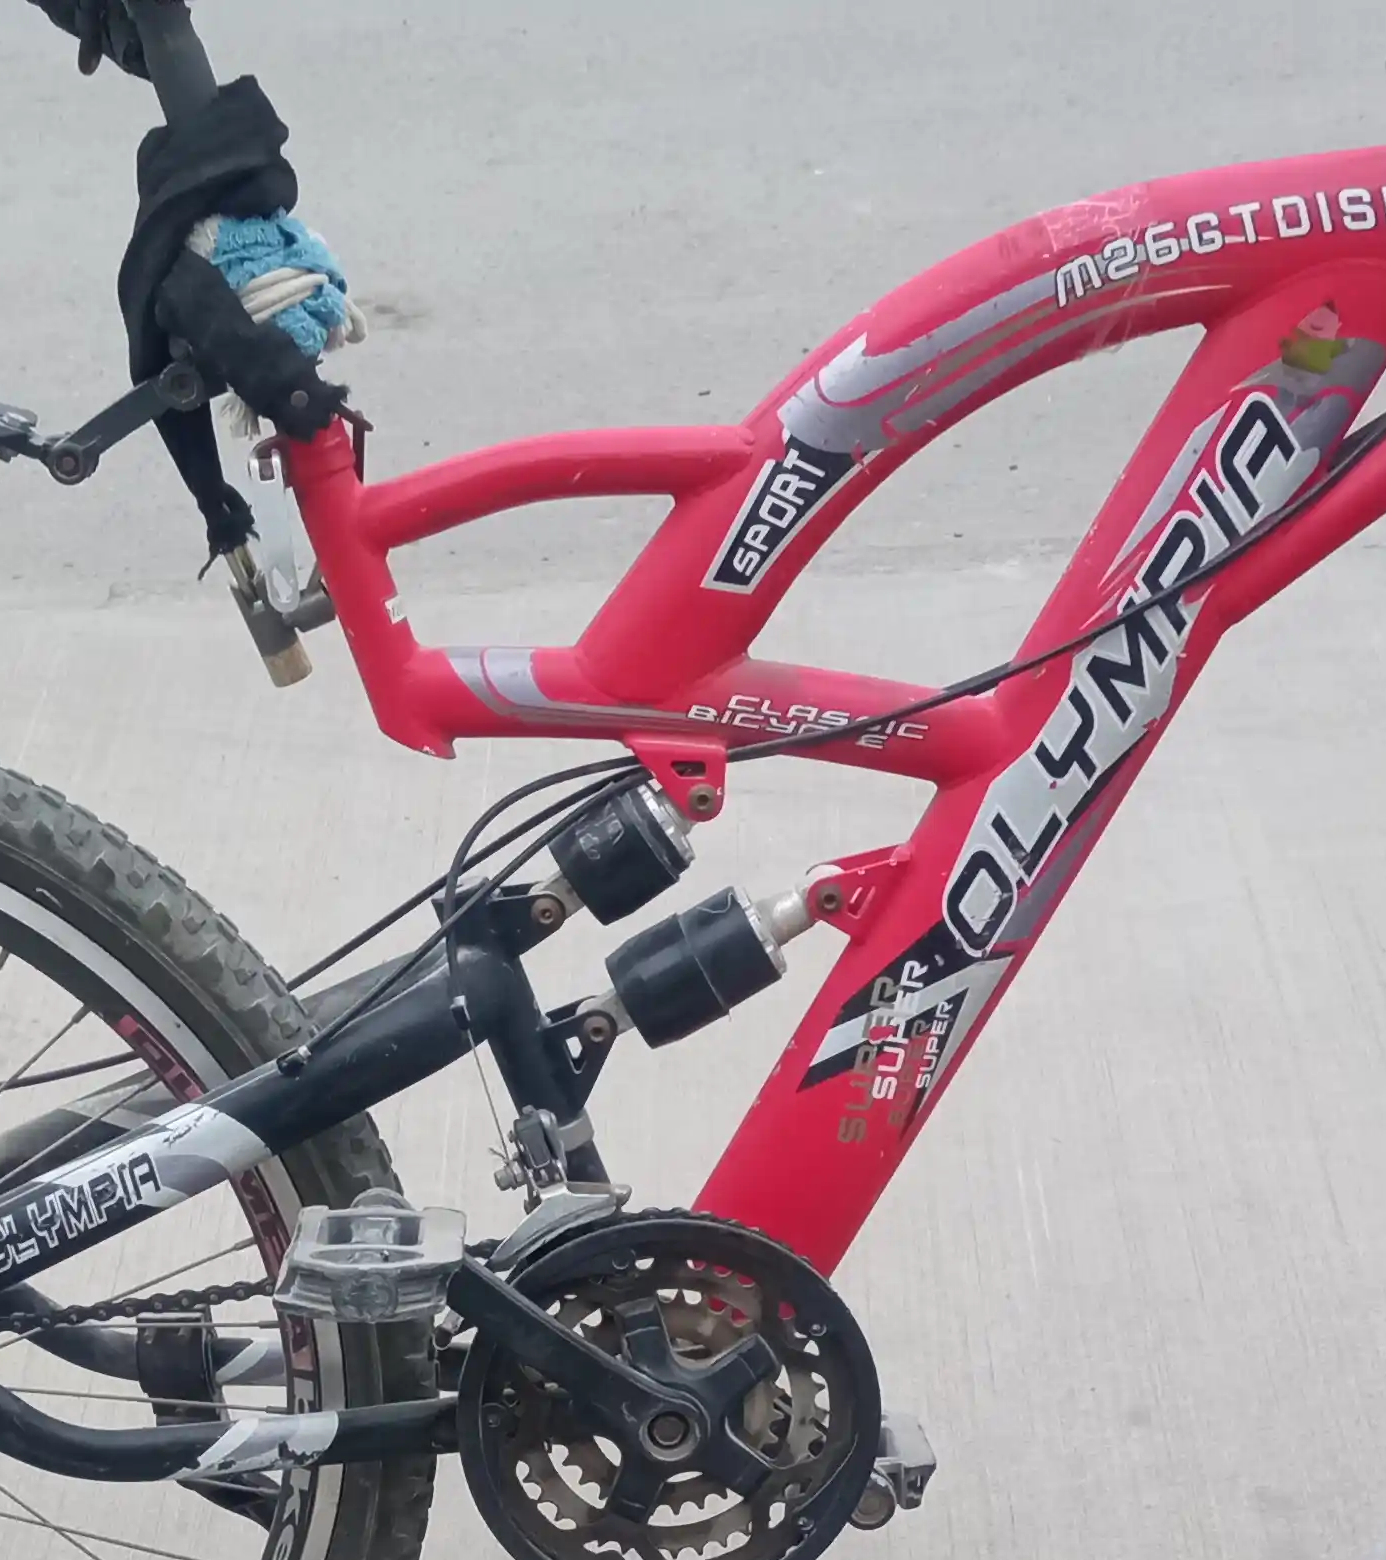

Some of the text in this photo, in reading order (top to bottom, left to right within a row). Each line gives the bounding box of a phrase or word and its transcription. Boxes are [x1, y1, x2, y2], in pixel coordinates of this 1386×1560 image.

[733, 448, 825, 577] SPORT
[944, 392, 1300, 957] OLYMPIA
[872, 960, 929, 1100] SUPER
[915, 1000, 954, 1089] SUPER
